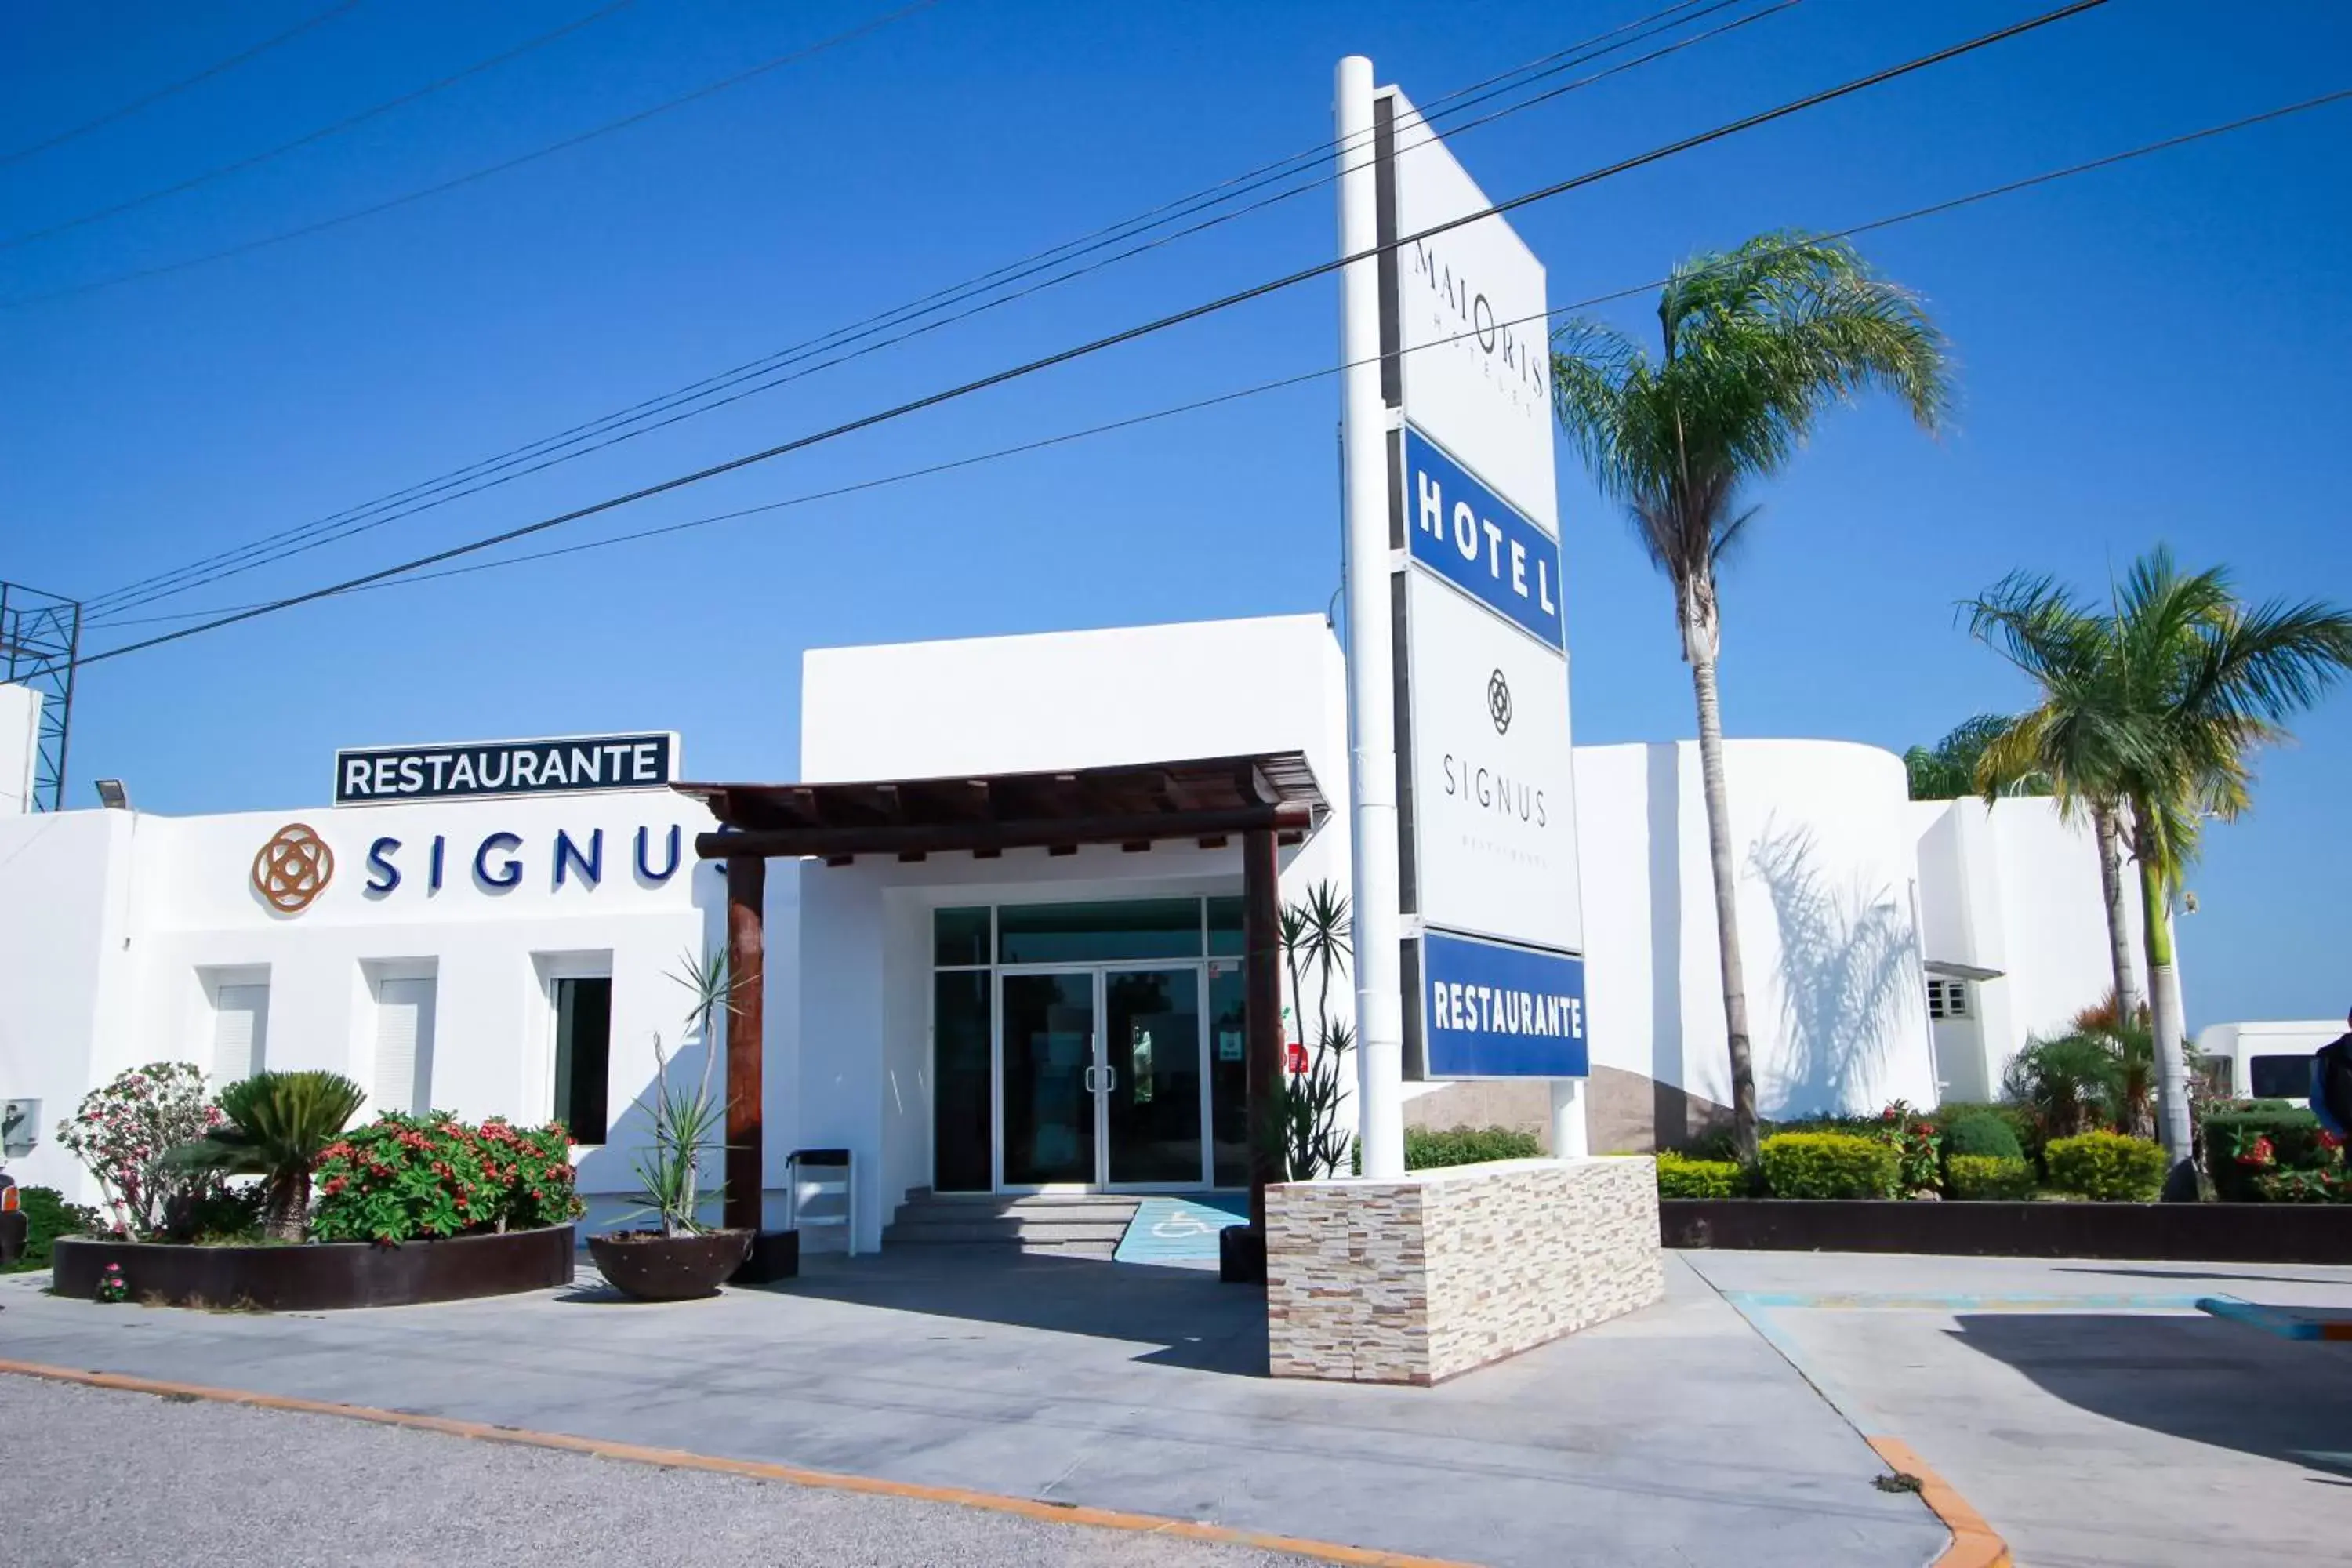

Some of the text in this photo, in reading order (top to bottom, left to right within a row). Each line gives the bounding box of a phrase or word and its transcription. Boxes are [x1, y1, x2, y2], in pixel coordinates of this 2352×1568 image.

[1414, 238, 1543, 398] MAIORIS
[1418, 470, 1555, 615] HOTEL
[344, 743, 659, 795] RESTAURANTE
[1444, 753, 1547, 827] SIGNUS
[365, 824, 729, 892] SIGNU
[1434, 981, 1581, 1039] RESTAURANTE
